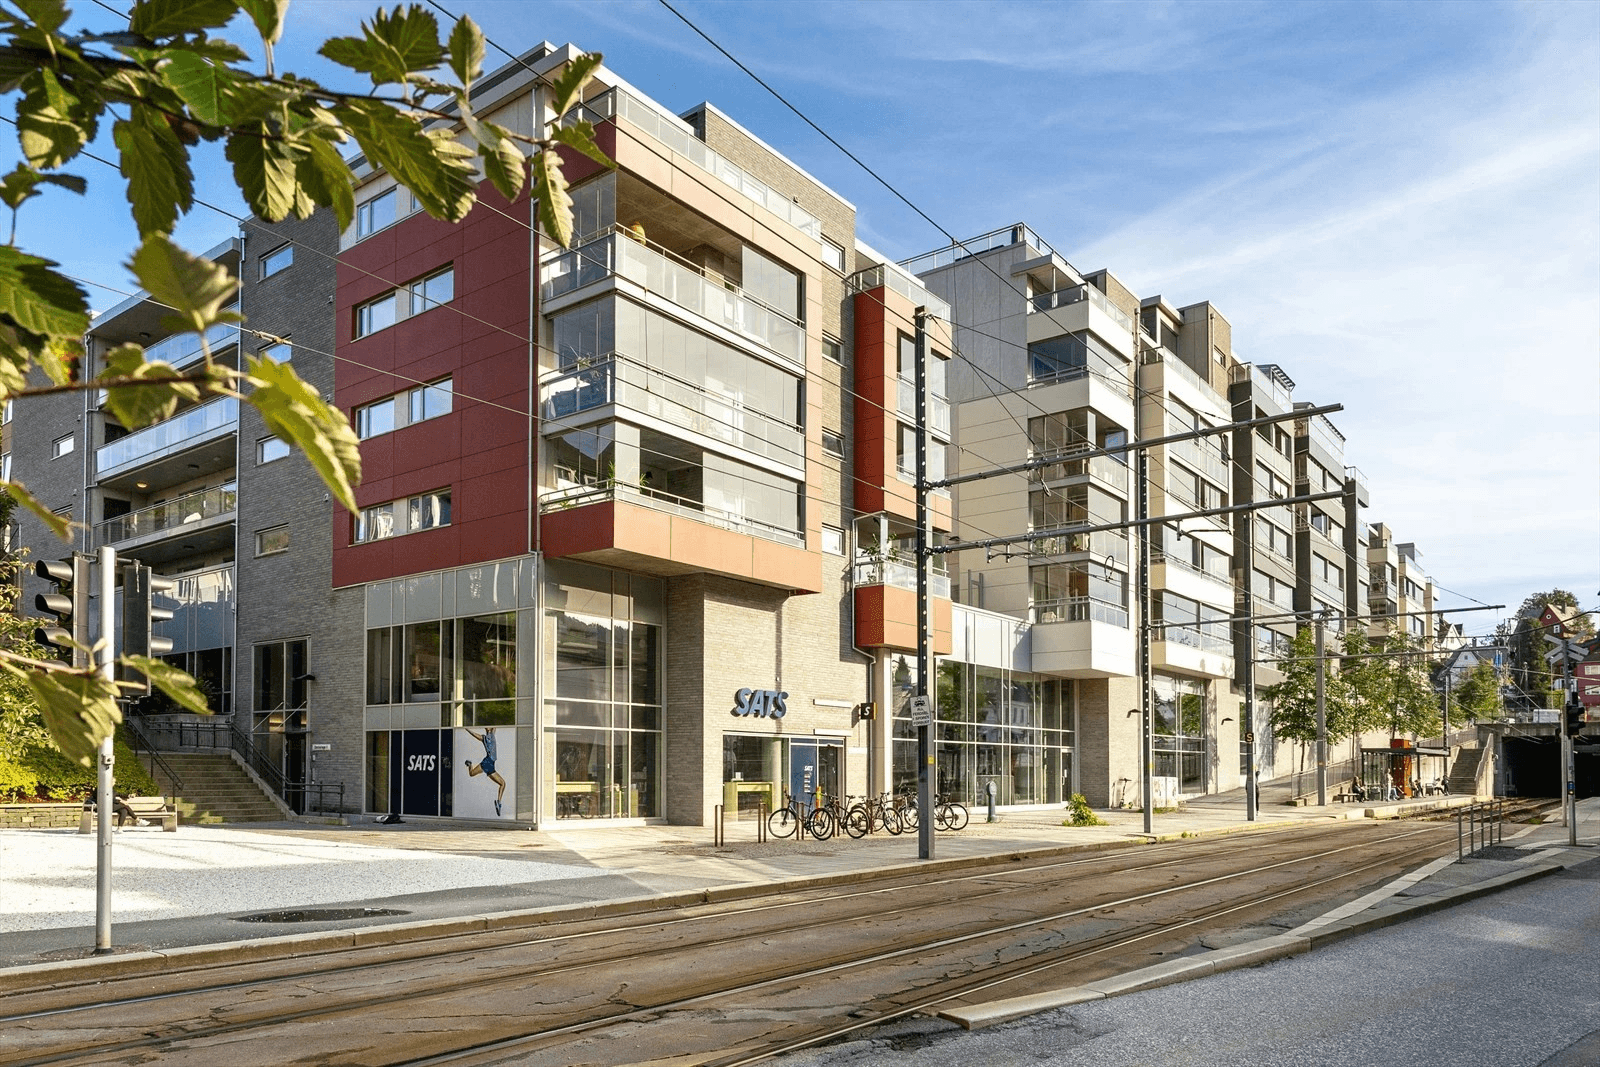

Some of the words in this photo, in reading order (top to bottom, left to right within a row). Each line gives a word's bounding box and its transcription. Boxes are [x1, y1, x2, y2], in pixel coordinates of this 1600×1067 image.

[730, 688, 789, 720] SATS
[1246, 733, 1253, 742] S
[407, 754, 437, 771] SATS
